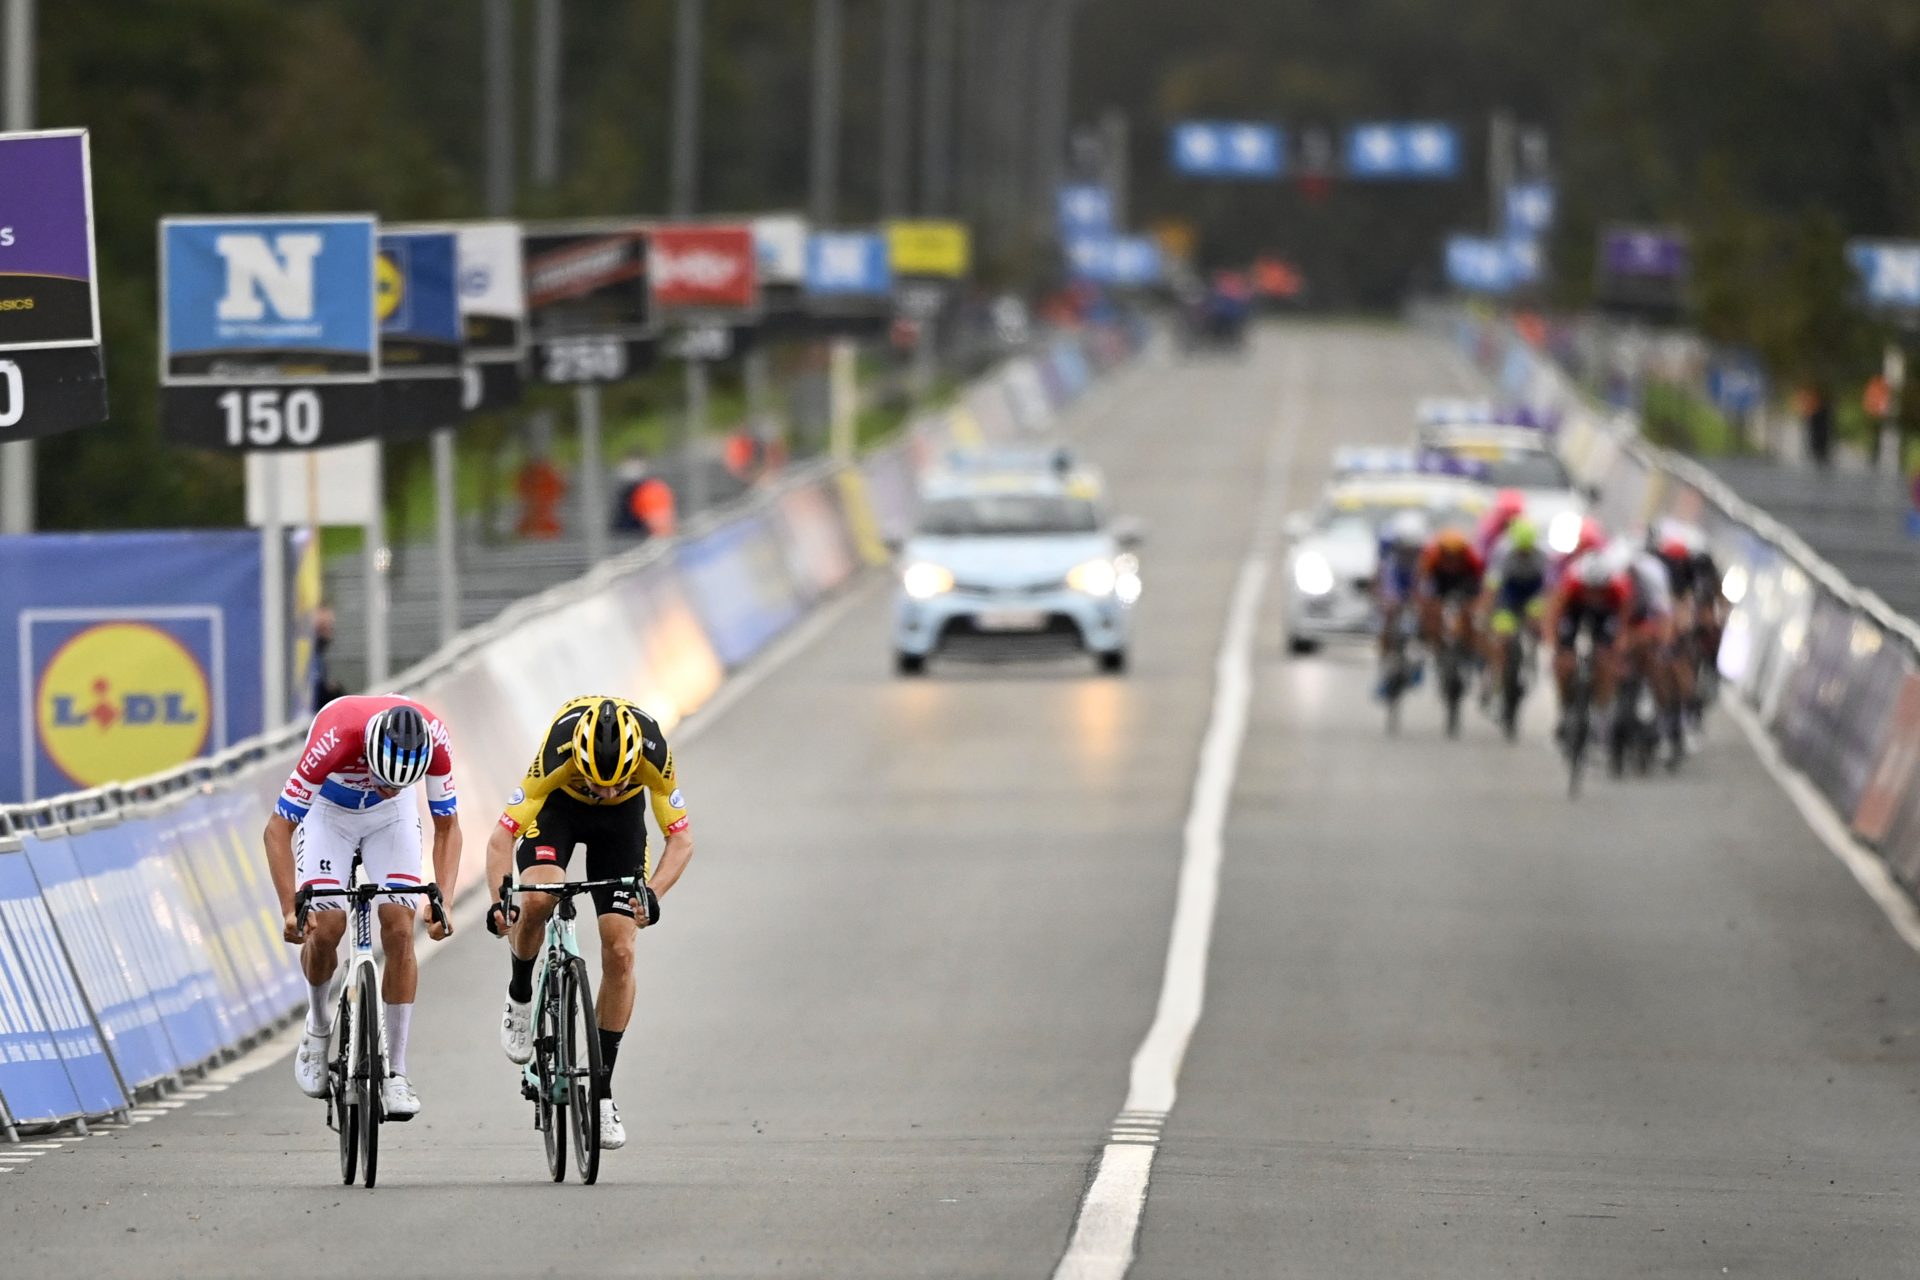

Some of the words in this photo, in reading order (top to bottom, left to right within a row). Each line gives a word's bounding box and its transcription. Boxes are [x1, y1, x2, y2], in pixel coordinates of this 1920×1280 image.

[216, 233, 322, 320] N
[218, 389, 322, 446] 150
[300, 727, 341, 776] FENIX
